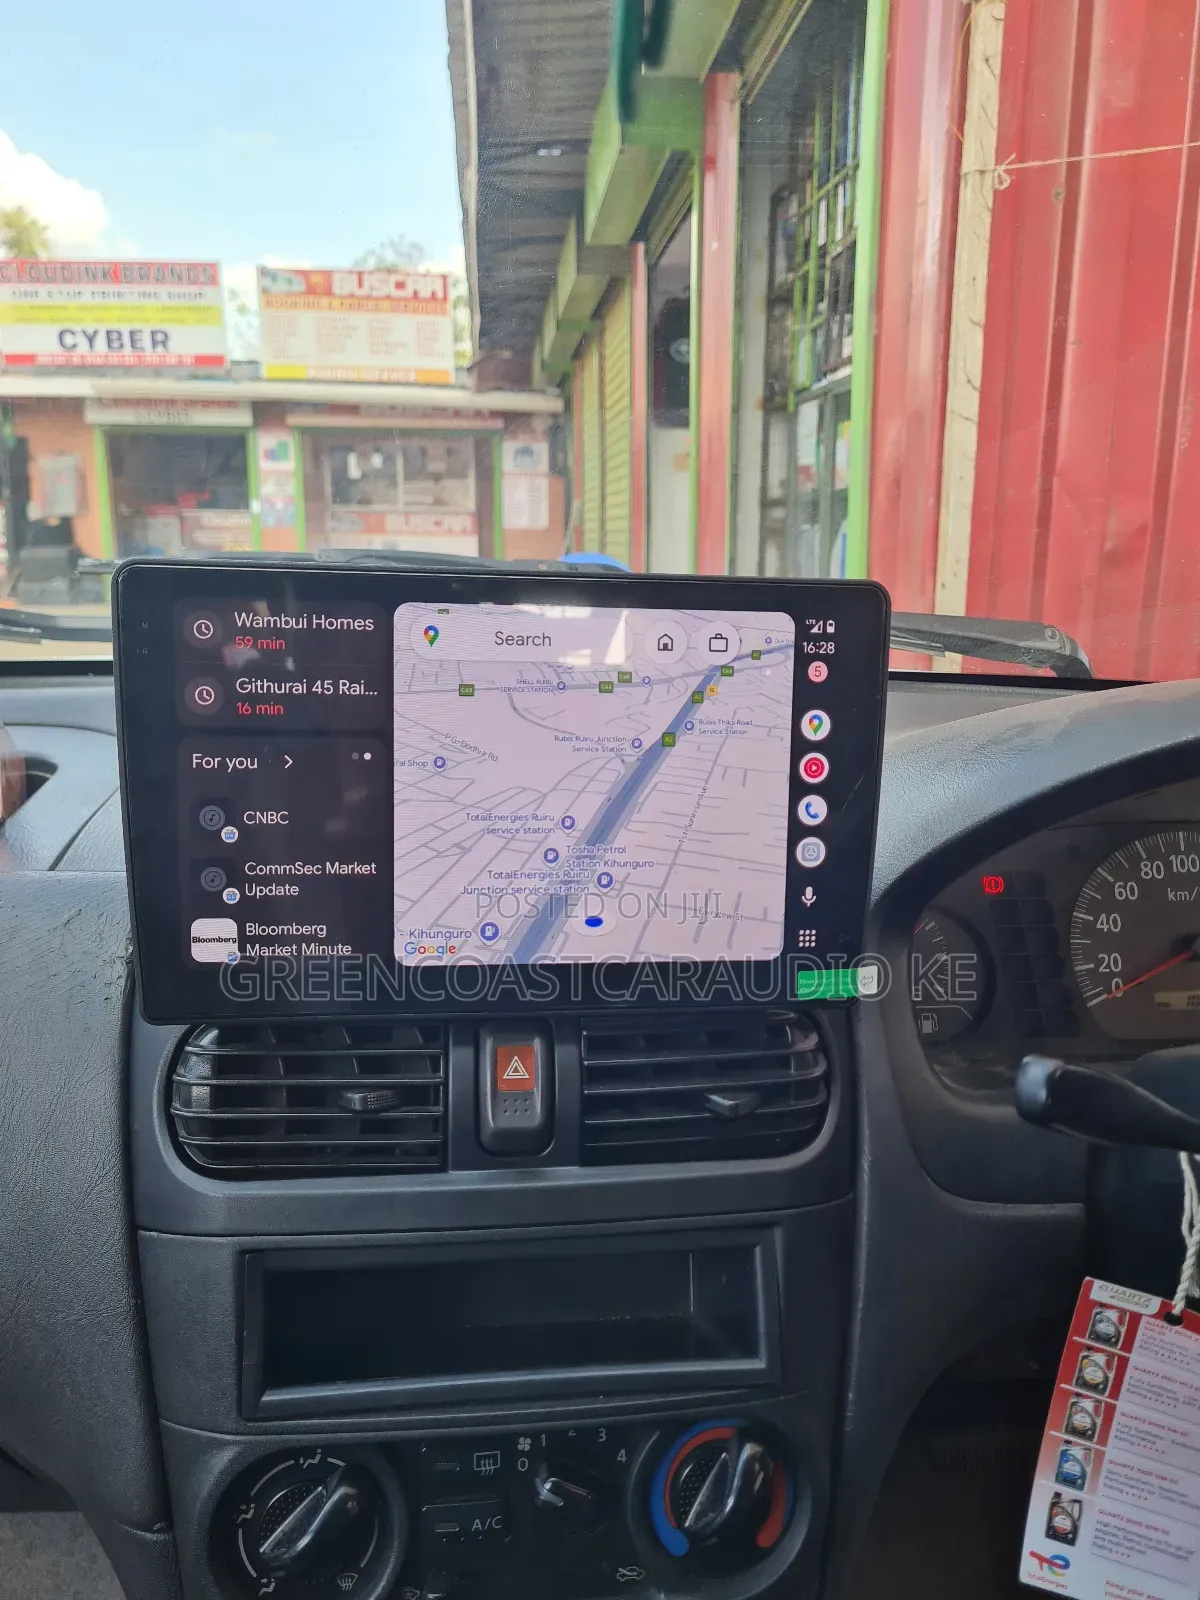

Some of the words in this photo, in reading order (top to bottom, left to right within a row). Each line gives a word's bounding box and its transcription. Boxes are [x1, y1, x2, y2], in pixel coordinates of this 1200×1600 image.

[121, 264, 214, 286] BRANDS
[58, 329, 171, 351] CYBER
[234, 612, 307, 629] Wambui
[312, 614, 375, 631] Homes
[235, 636, 253, 649] 59
[257, 637, 286, 650] min
[494, 631, 552, 647] Search
[802, 642, 835, 654] 16:28
[814, 665, 822, 678] 5
[236, 678, 307, 695] Githurai
[311, 680, 334, 695] 45
[339, 680, 378, 696] Rai...
[236, 702, 252, 715] 16
[256, 702, 284, 715] min
[601, 745, 627, 753] Station
[192, 753, 221, 769] For
[226, 756, 258, 773] you
[407, 759, 429, 768] Shop
[487, 752, 499, 762] Rd
[697, 785, 708, 800] Ave
[243, 811, 290, 824] CNBC
[465, 812, 529, 823] TotalEnergies
[531, 813, 555, 822] Ruiru
[486, 827, 520, 835] service
[523, 826, 555, 835] station
[565, 845, 595, 854] Tosha
[596, 845, 627, 854] Petrol
[244, 861, 322, 875] CommSec
[326, 861, 377, 875] Market
[565, 859, 601, 868] Station
[603, 859, 655, 870] Kihunguro
[1140, 860, 1165, 879] 80
[1169, 854, 1200, 873] 100
[487, 870, 560, 881] TotalEnergies
[563, 870, 590, 879] Ruiru
[245, 883, 300, 899] Update
[460, 885, 509, 895] Junction
[511, 885, 550, 894] service
[553, 884, 589, 893] station
[1114, 881, 1139, 900] 60
[1168, 886, 1200, 901] km/
[735, 912, 744, 921] St
[1096, 913, 1122, 932] 40
[246, 922, 327, 937] Bloomberg
[409, 928, 472, 941] Kihunguro
[191, 936, 237, 944] Bloomberg
[246, 943, 298, 956] Market
[301, 943, 352, 956] Minute
[404, 941, 457, 957] Google
[1098, 953, 1122, 972] 20
[1111, 977, 1124, 998] 0
[540, 1434, 547, 1447] 1
[597, 1428, 607, 1442] 3
[616, 1449, 627, 1463] 4
[517, 1458, 529, 1472] 0
[472, 1516, 502, 1532] A/C
